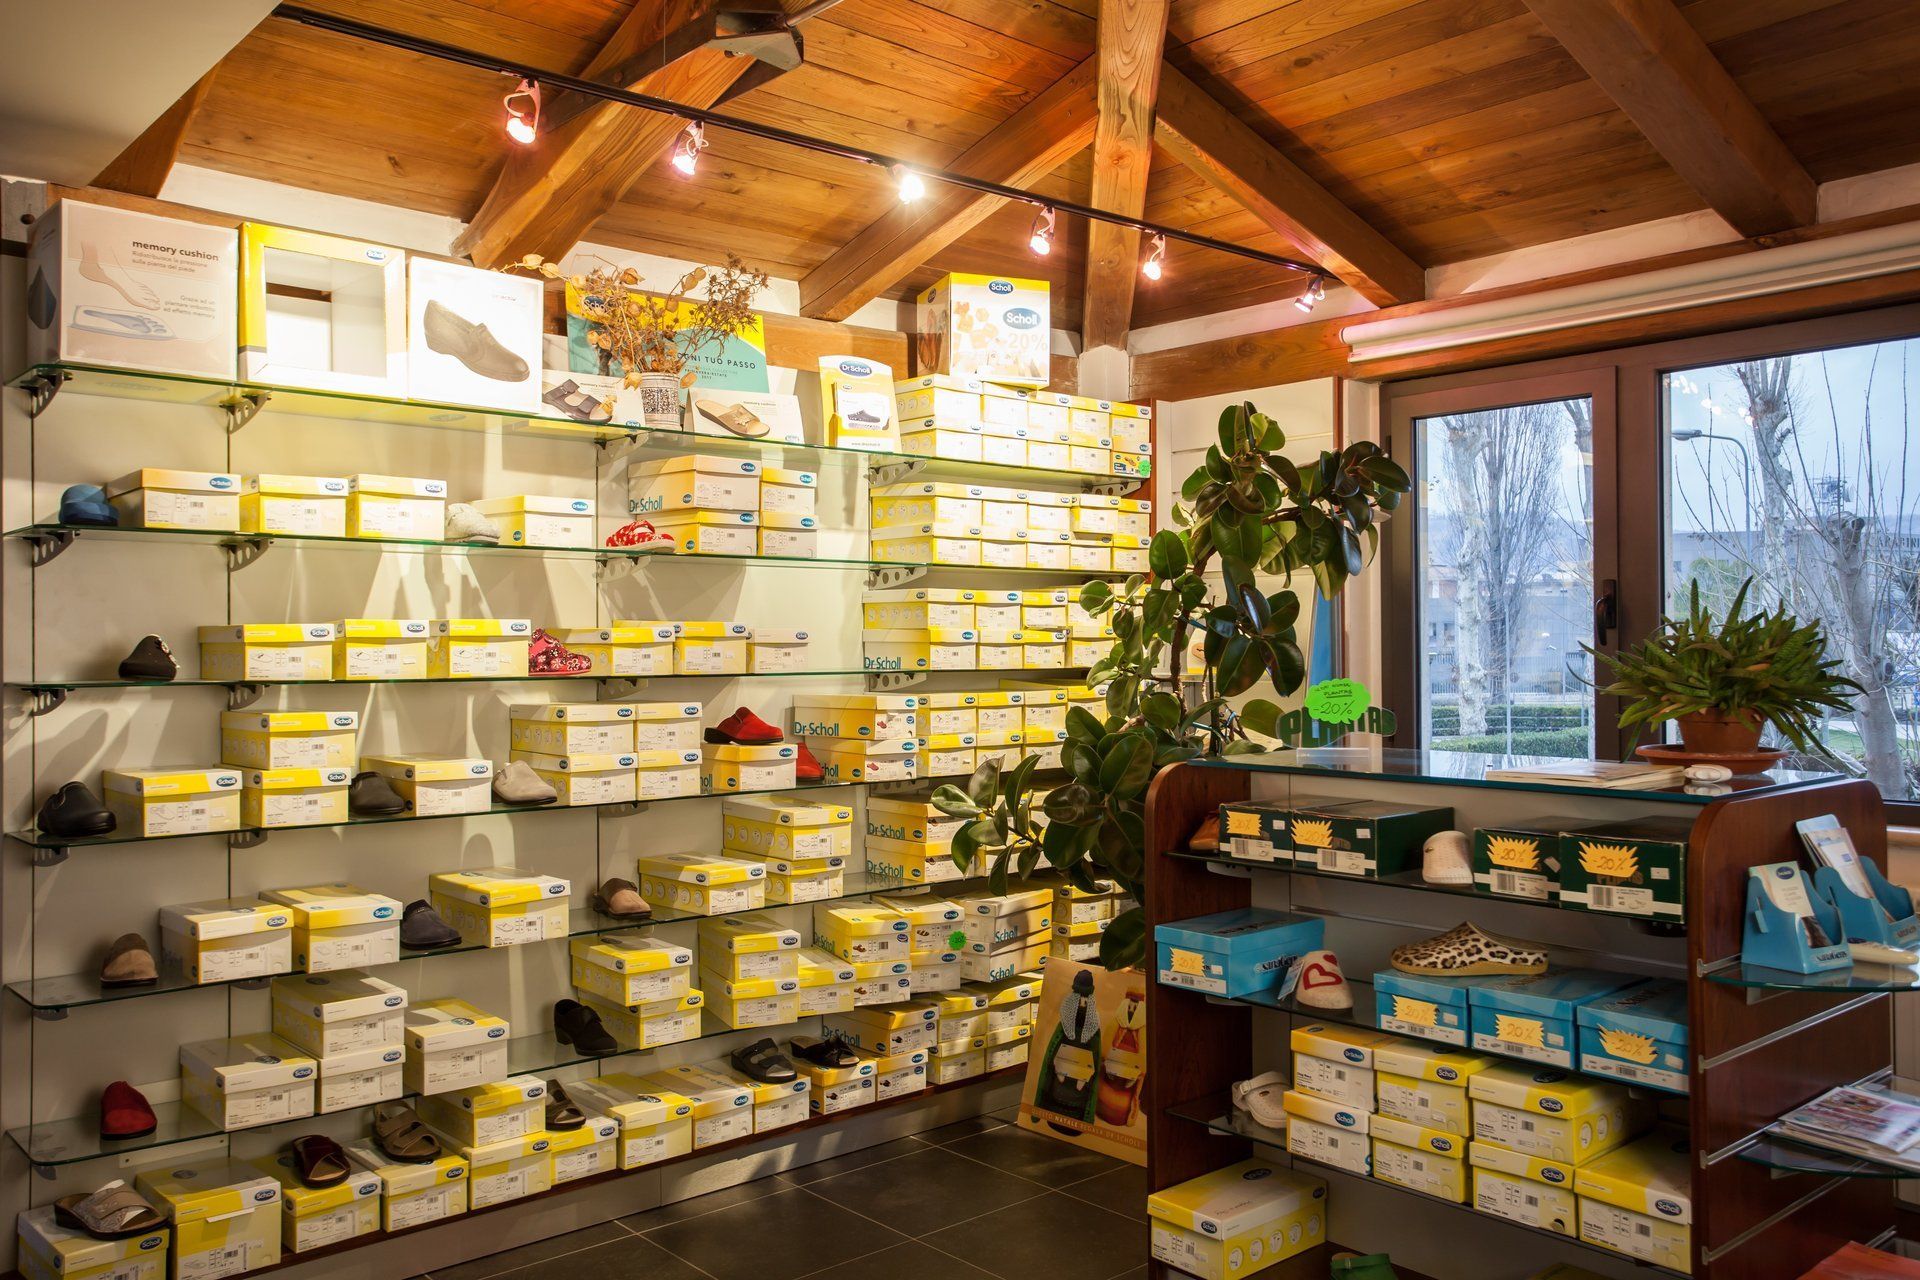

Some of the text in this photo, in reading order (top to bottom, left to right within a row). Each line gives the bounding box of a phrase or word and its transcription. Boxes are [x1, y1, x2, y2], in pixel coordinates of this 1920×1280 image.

[132, 240, 219, 261] memory cushion
[991, 283, 1011, 292] Scholl
[1006, 312, 1037, 325] Scholl
[704, 356, 723, 365] TUO
[727, 360, 756, 370] PASSO
[640, 496, 662, 511] Scholl
[876, 656, 901, 670] Scholl
[1312, 700, 1356, 716] -20%
[808, 722, 838, 736] Scholl
[880, 825, 904, 840] Scholl
[878, 862, 903, 878] Scholl
[1593, 856, 1628, 872] -20%
[1438, 1069, 1456, 1078] Scholl
[1540, 1100, 1562, 1110] Scholl
[1054, 1116, 1078, 1128] NATALE
[1336, 1115, 1354, 1124] Scholl
[1432, 1140, 1450, 1149] Scholl
[1542, 1170, 1564, 1180] Scholl
[1657, 1201, 1681, 1214] Scholl
